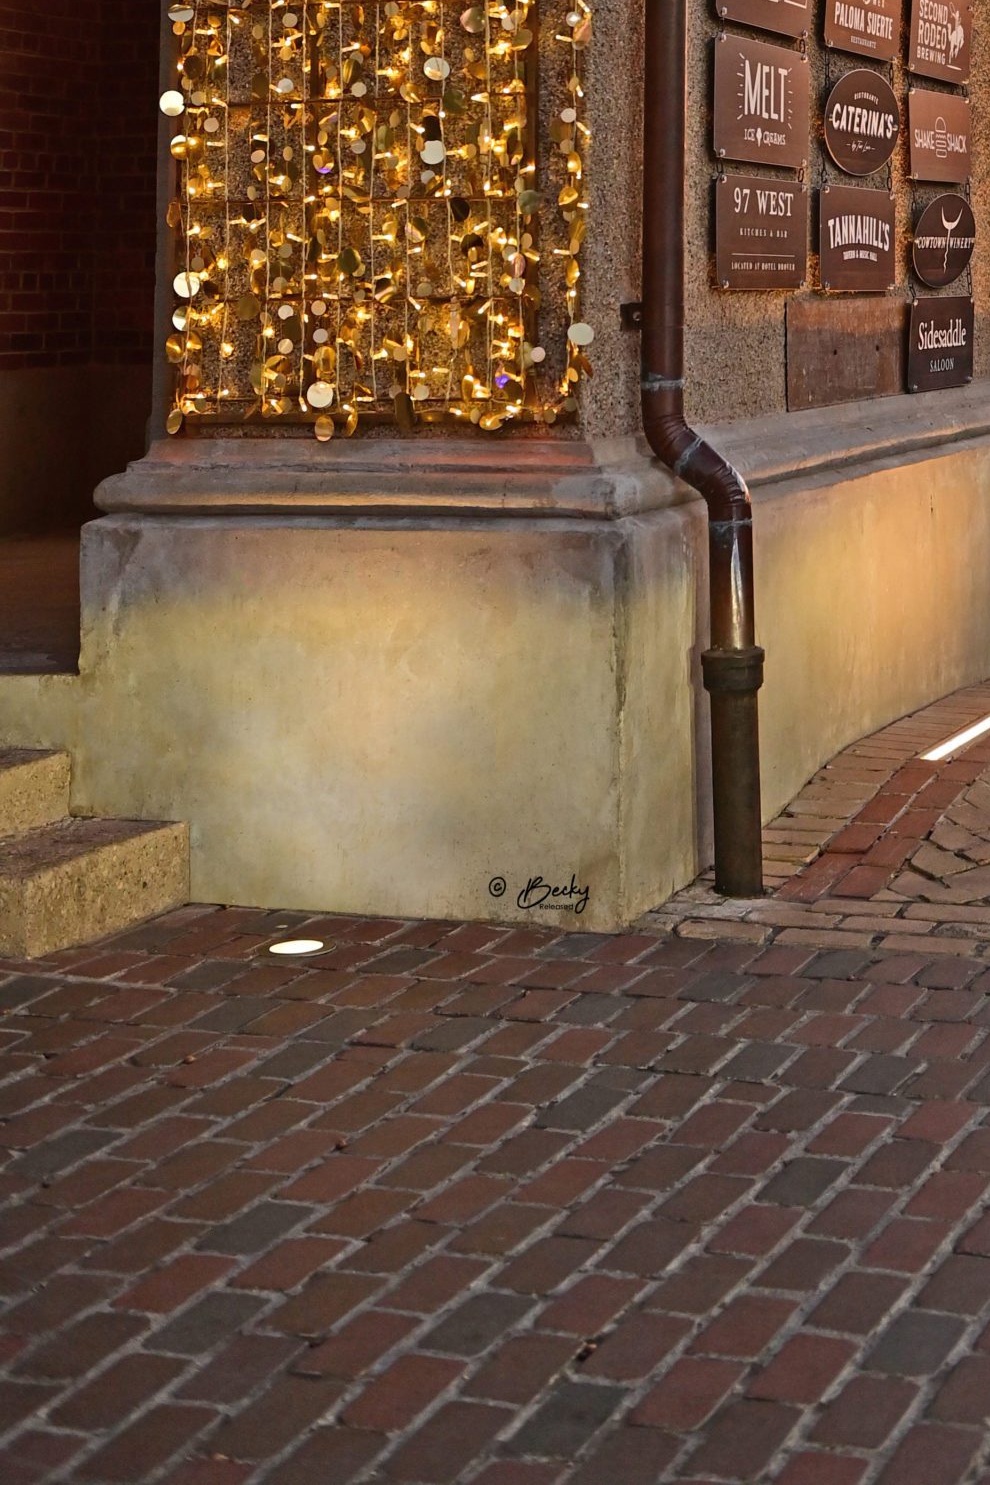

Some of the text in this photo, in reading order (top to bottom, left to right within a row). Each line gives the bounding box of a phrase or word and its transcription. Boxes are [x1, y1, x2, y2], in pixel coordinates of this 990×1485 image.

[834, 1, 893, 40] PALOMA SUERTE
[917, 19, 947, 51] RODEO
[916, 46, 946, 65] BREWING
[744, 59, 788, 123] MELT
[744, 128, 786, 146] ICE CREAMS
[832, 103, 894, 140] CATERINA'S
[914, 129, 967, 154] SHAKE SHACK
[733, 186, 794, 217] 97 WEST
[828, 215, 890, 252] TANNAHILL'S
[918, 236, 971, 249] COWTOWN WINERY
[761, 262, 777, 271] HOTEL
[918, 318, 967, 351] Sidesaddle
[929, 357, 954, 373] SALOON
